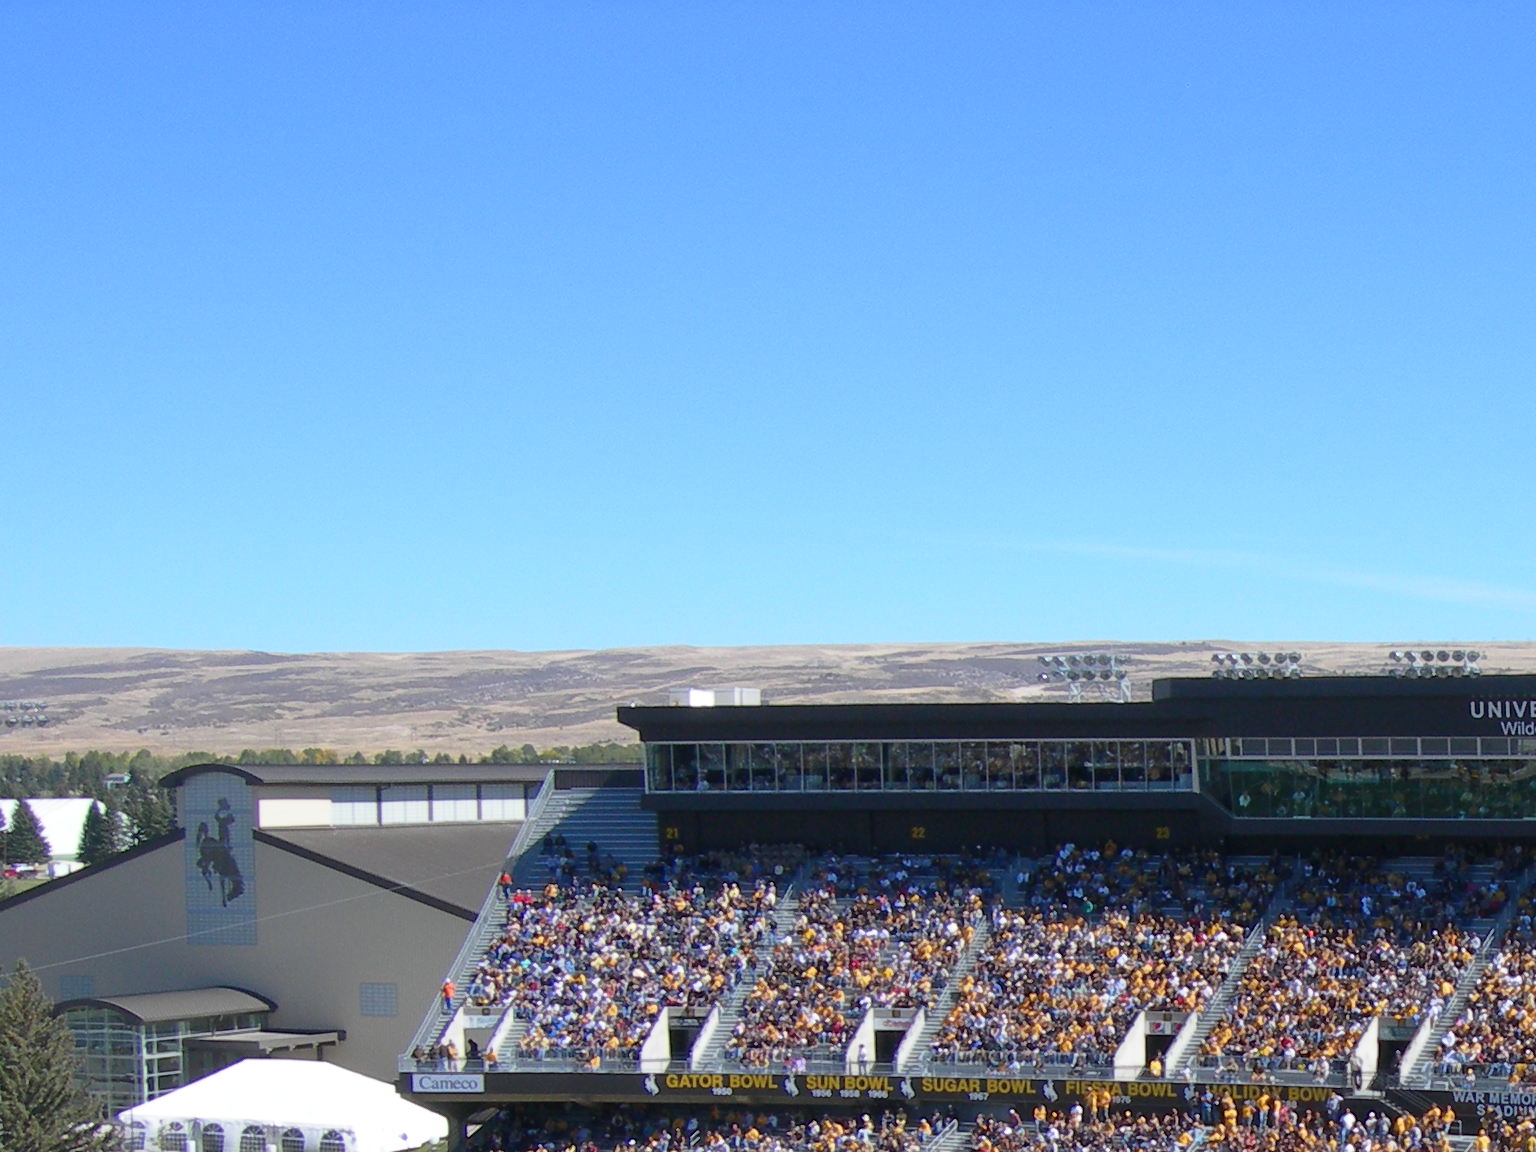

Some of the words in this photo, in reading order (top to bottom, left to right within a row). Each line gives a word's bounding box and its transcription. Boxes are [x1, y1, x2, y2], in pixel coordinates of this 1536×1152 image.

[418, 1076, 478, 1091] Cameco
[666, 1074, 724, 1089] GATOR
[729, 1074, 778, 1089] BOWL
[806, 1075, 840, 1091] SUN
[844, 1076, 894, 1092] BOWL
[922, 1077, 980, 1093] SUGAR
[986, 1078, 1036, 1094] BOWL
[1066, 1081, 1124, 1097] FIESTA
[1128, 1082, 1178, 1098] BOWL
[1452, 1091, 1485, 1104] WAR
